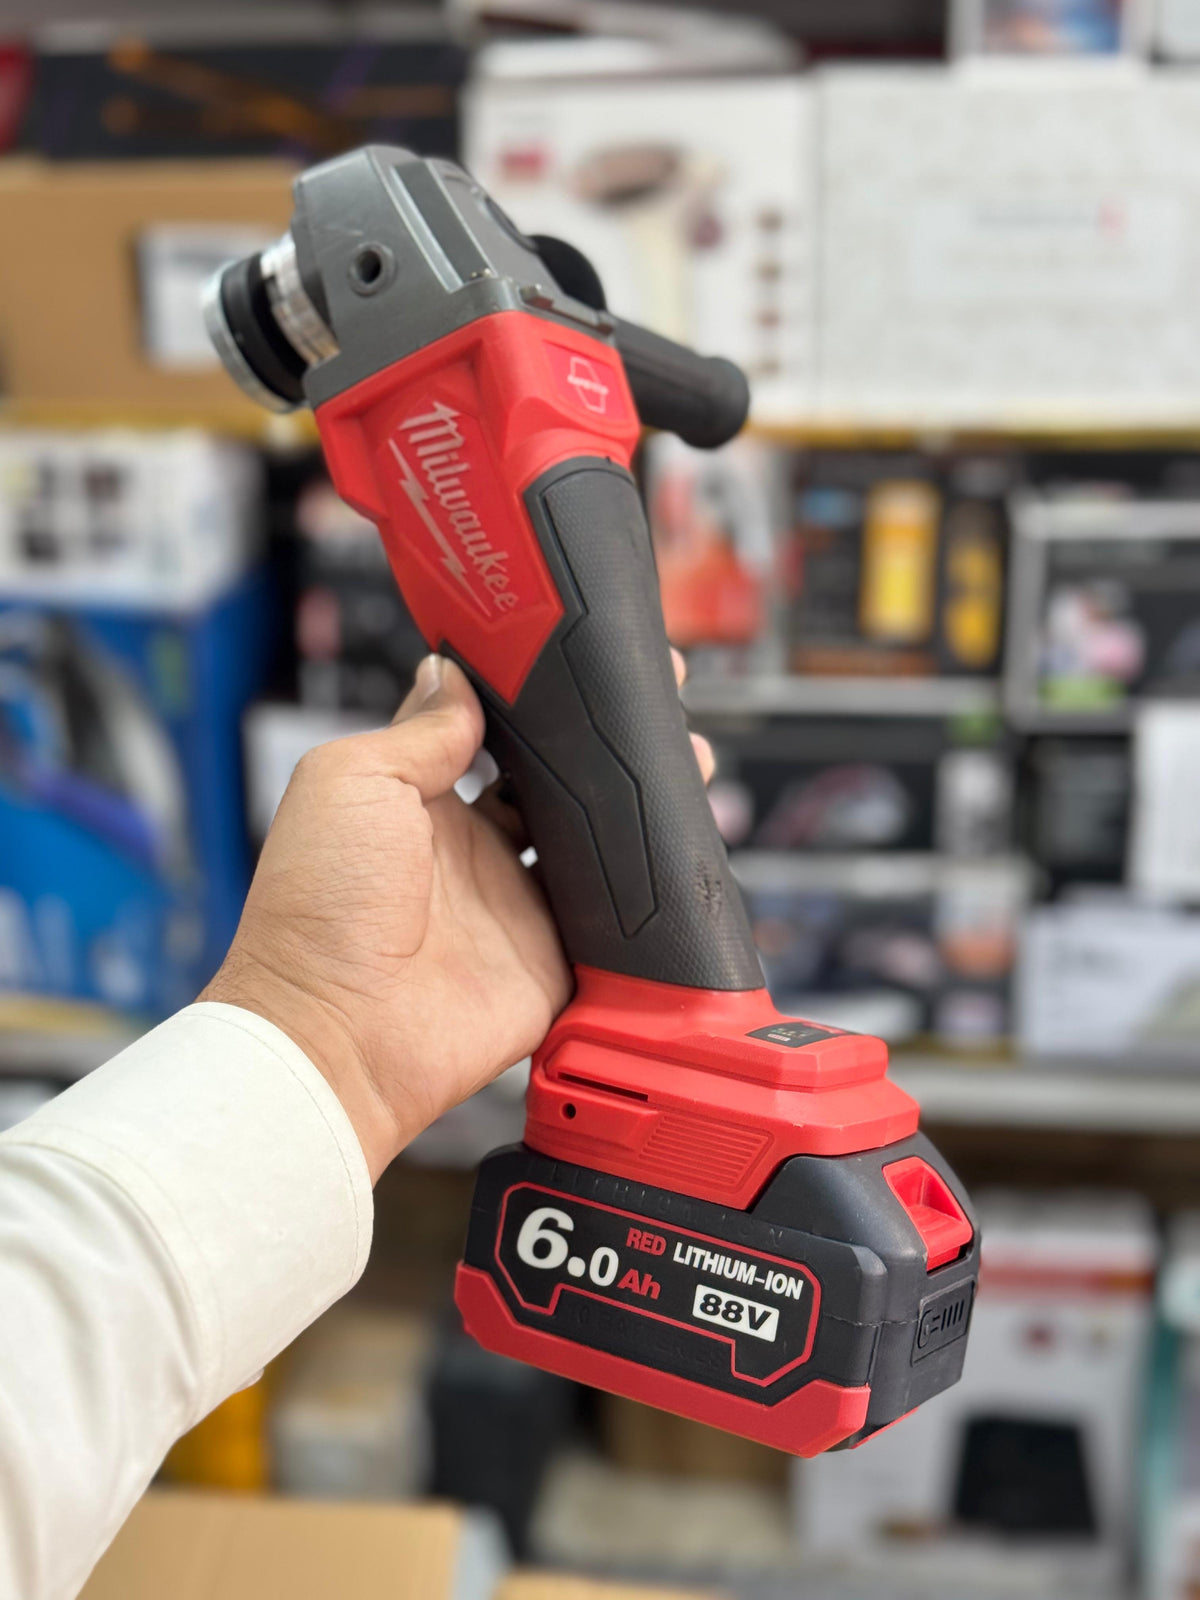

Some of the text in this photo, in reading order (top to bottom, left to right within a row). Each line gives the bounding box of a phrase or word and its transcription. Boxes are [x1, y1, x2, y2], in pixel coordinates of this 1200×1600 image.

[398, 401, 519, 612] Milwaukee
[516, 1207, 619, 1287] 6.0
[626, 1227, 804, 1300] RED LITHIUM-ION
[617, 1268, 661, 1300] Ah
[699, 1293, 772, 1331] 88V
